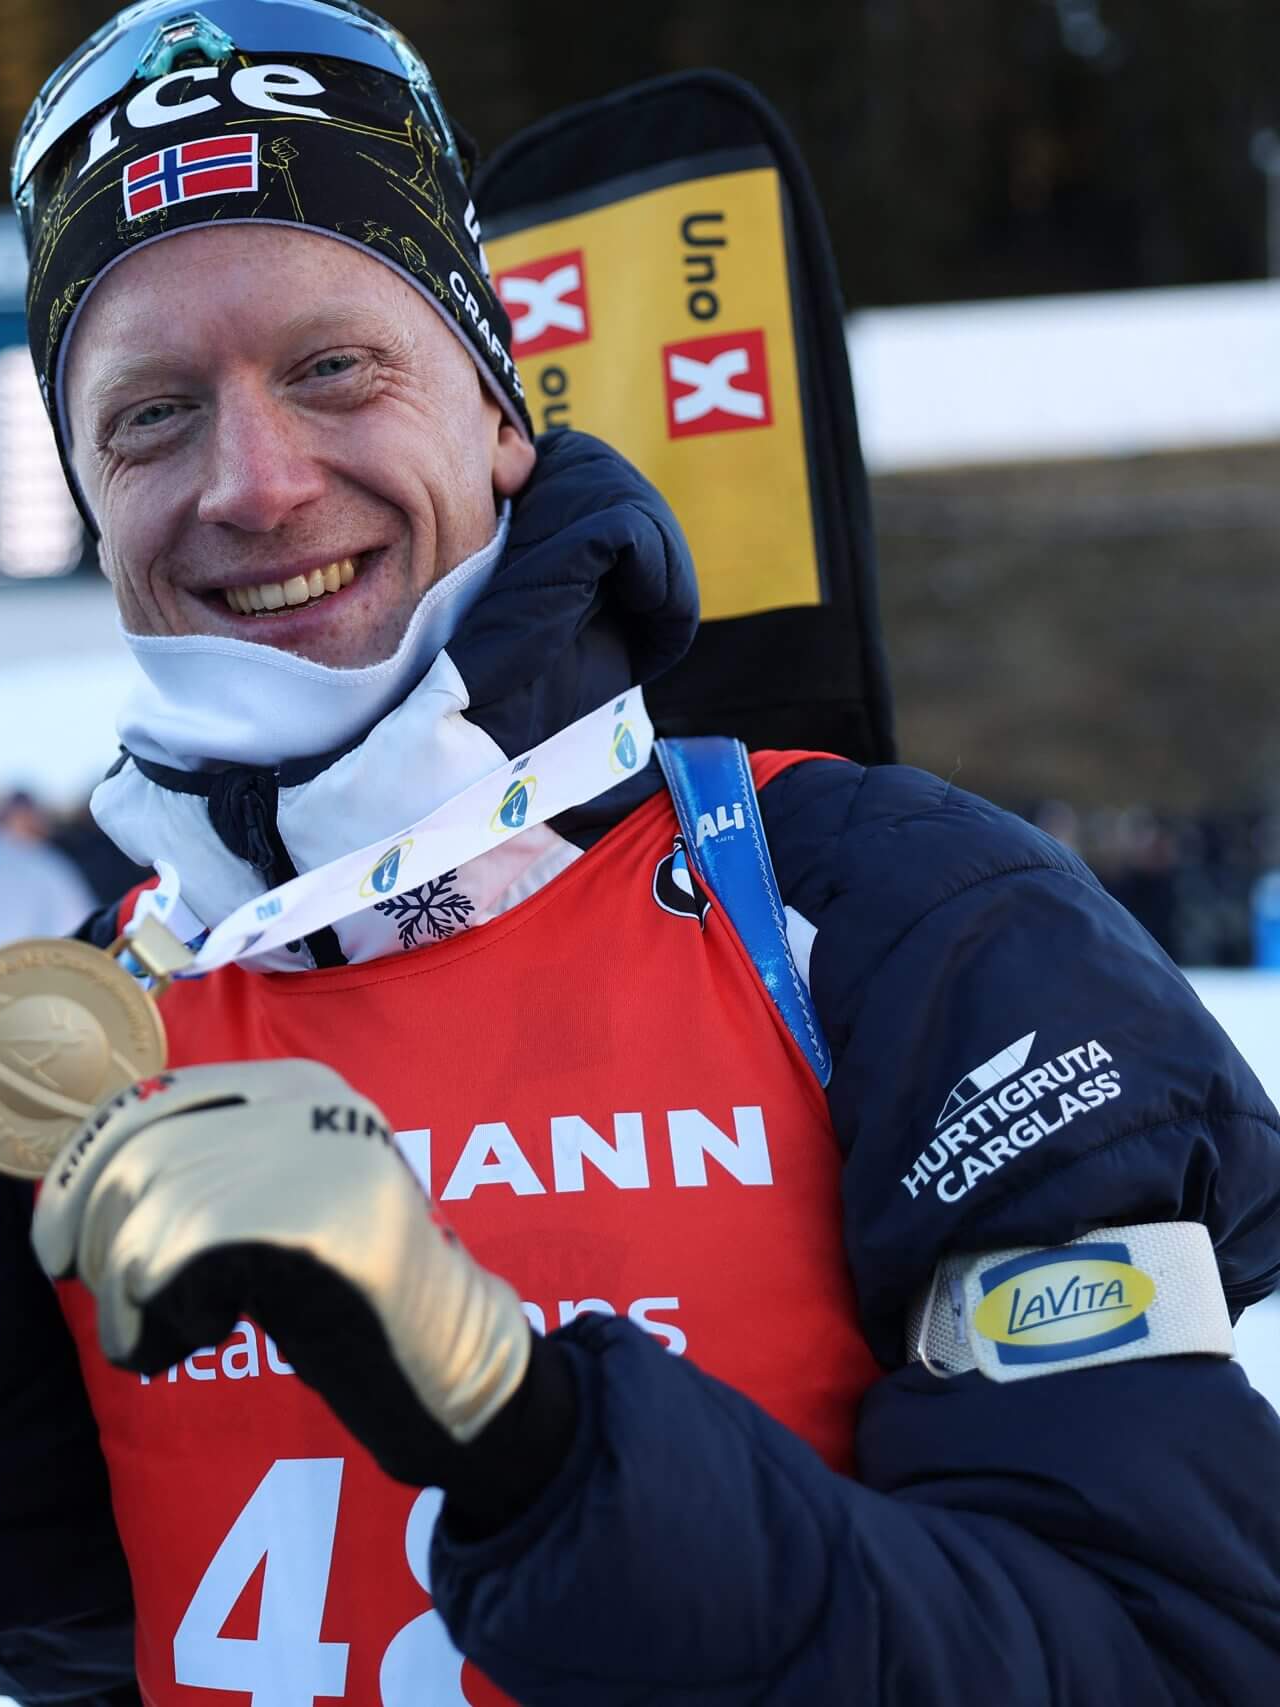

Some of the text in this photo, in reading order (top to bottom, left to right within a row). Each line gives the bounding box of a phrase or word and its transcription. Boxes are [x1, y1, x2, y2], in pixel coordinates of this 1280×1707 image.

[668, 211, 766, 425] Uno X
[539, 365, 571, 432] no
[901, 1039, 1113, 1199] HURTIGRUTA
